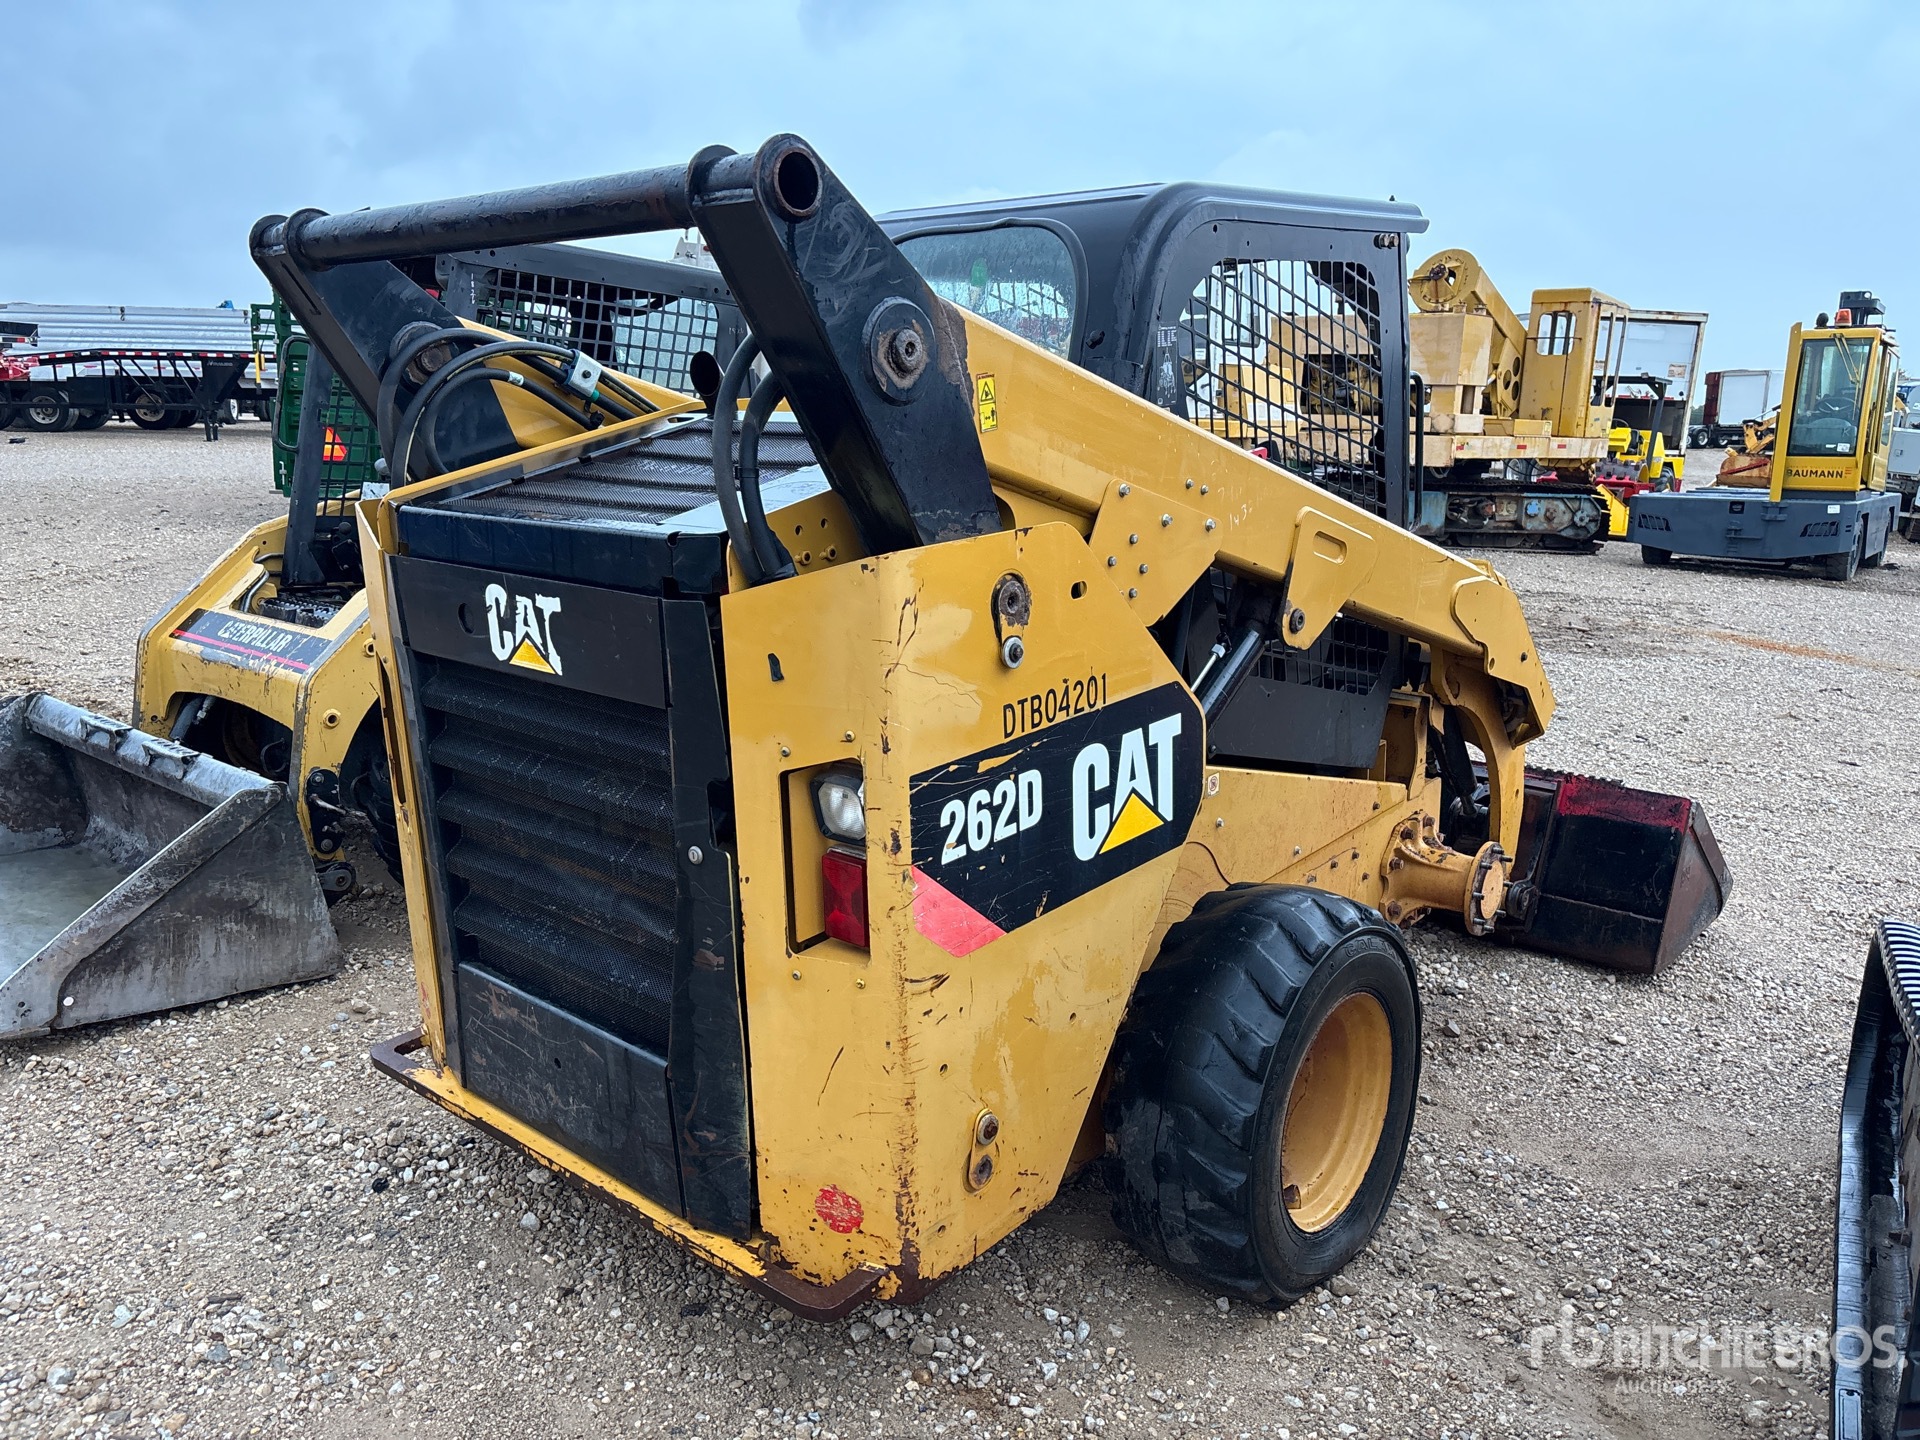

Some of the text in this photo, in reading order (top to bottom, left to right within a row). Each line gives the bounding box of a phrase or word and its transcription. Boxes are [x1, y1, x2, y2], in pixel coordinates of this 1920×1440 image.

[1786, 468, 1844, 479] BAUMANN
[217, 620, 293, 653] CATERPILLAR
[485, 584, 563, 677] CAT
[1002, 672, 1107, 740] DTB04201
[940, 712, 1182, 866] 262D CAT
